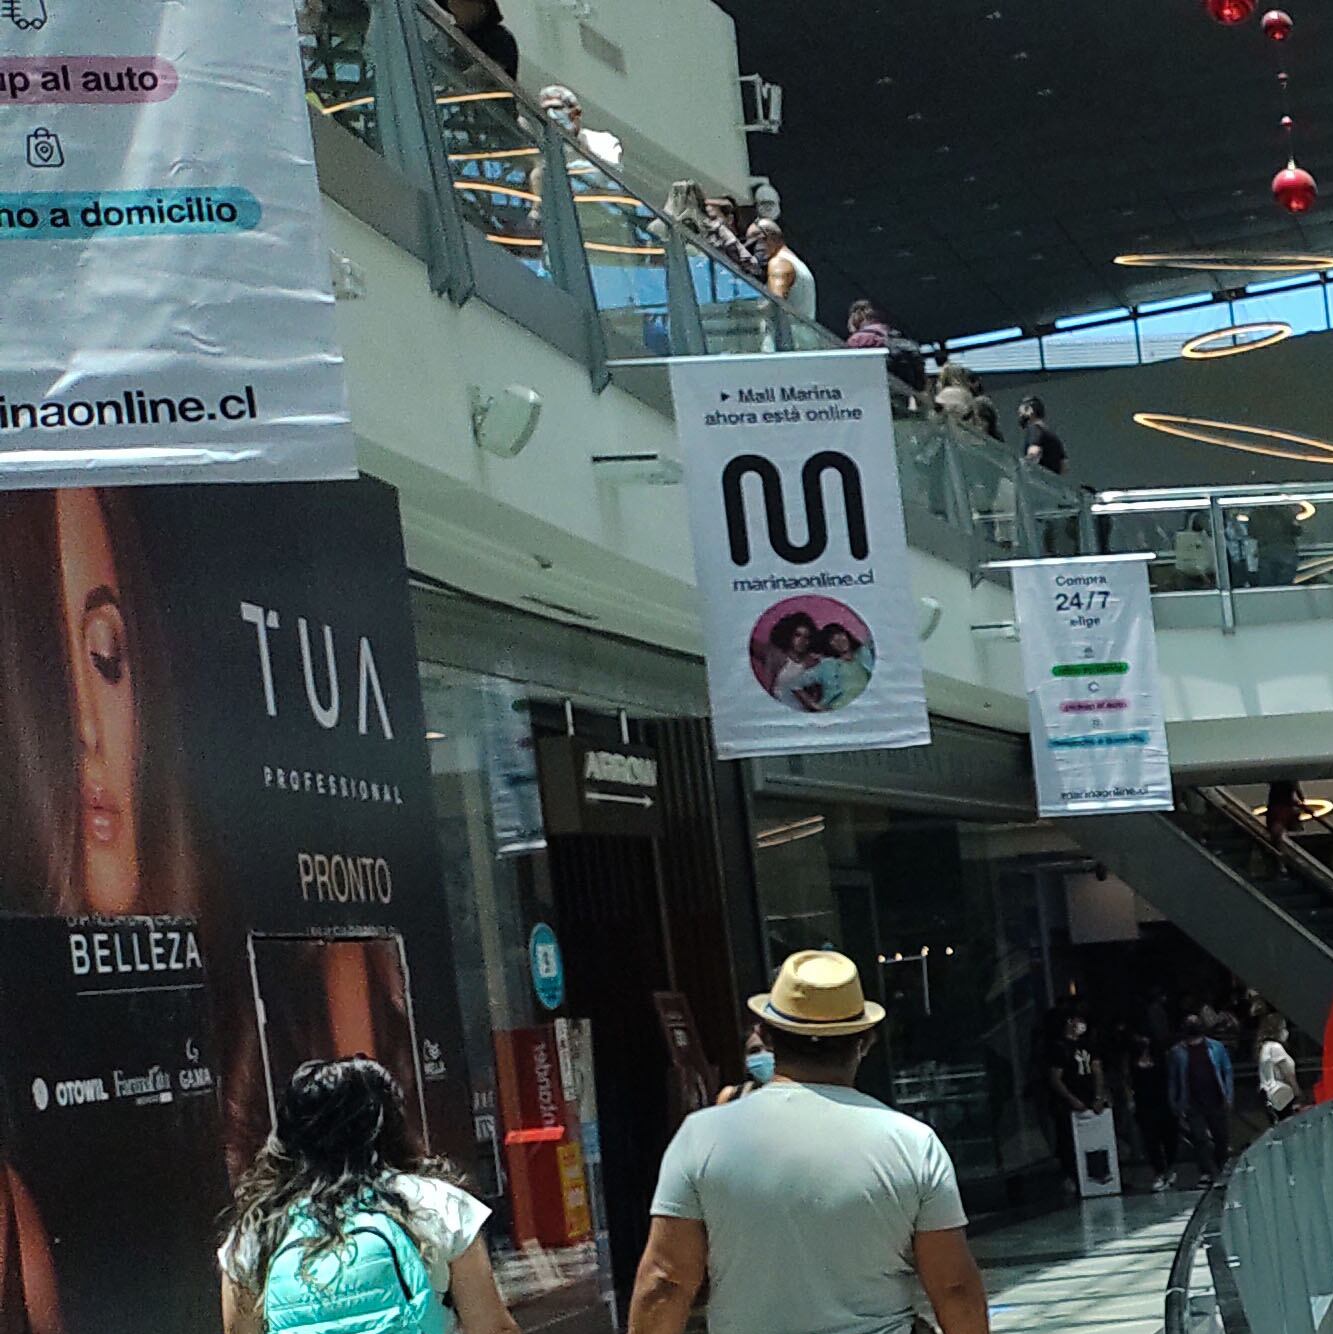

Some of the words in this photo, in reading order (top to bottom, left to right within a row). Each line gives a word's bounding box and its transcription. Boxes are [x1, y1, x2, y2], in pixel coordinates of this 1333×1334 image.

[41, 65, 70, 91] al
[82, 67, 158, 91] auto
[50, 207, 71, 228] a
[80, 197, 237, 228] domicilio
[738, 387, 775, 403] Mall
[780, 384, 842, 401] Marina
[704, 409, 758, 426] ahora
[806, 405, 862, 422] online
[1056, 574, 1107, 587] Compra
[1055, 591, 1111, 612] 24/7
[240, 602, 394, 740] TUA
[298, 853, 392, 904] PRONTO
[69, 931, 202, 975] BELLEZA
